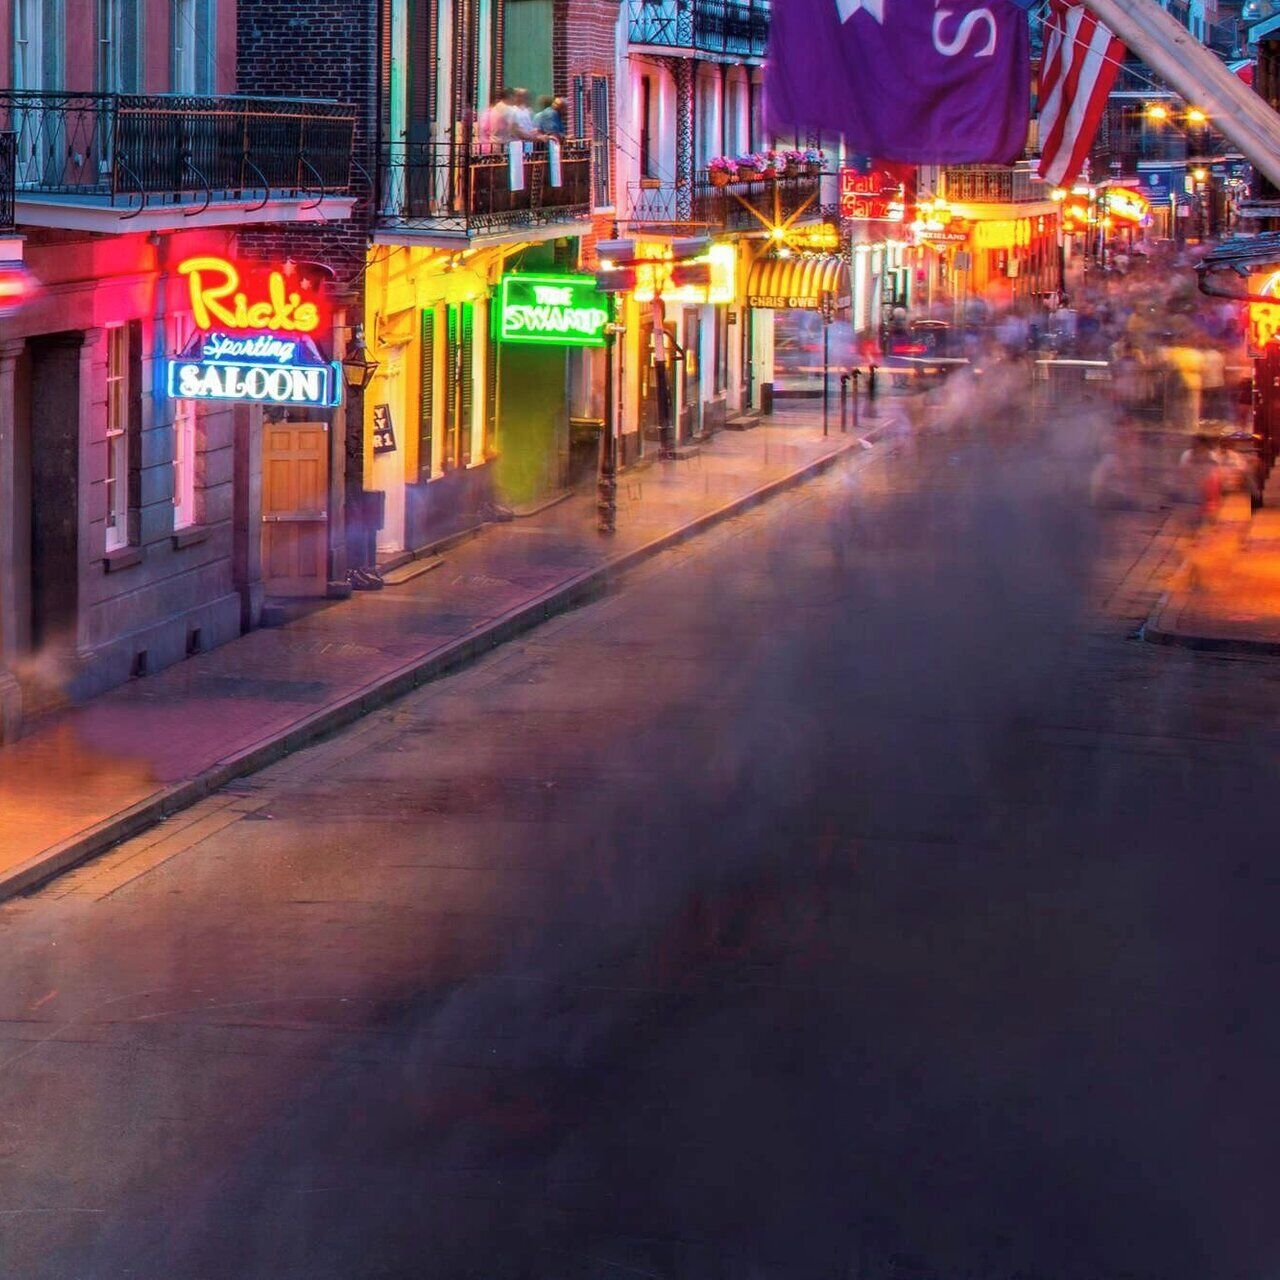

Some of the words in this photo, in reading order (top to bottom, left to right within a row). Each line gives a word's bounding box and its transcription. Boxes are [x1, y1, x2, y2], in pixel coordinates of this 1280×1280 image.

[178, 257, 319, 332] Rick's
[533, 286, 574, 305] THE
[750, 296, 785, 307] CHRIS
[788, 296, 820, 308] OWE
[506, 305, 608, 335] SWAMP
[203, 333, 295, 362] Sporting
[179, 365, 320, 400] SALOON
